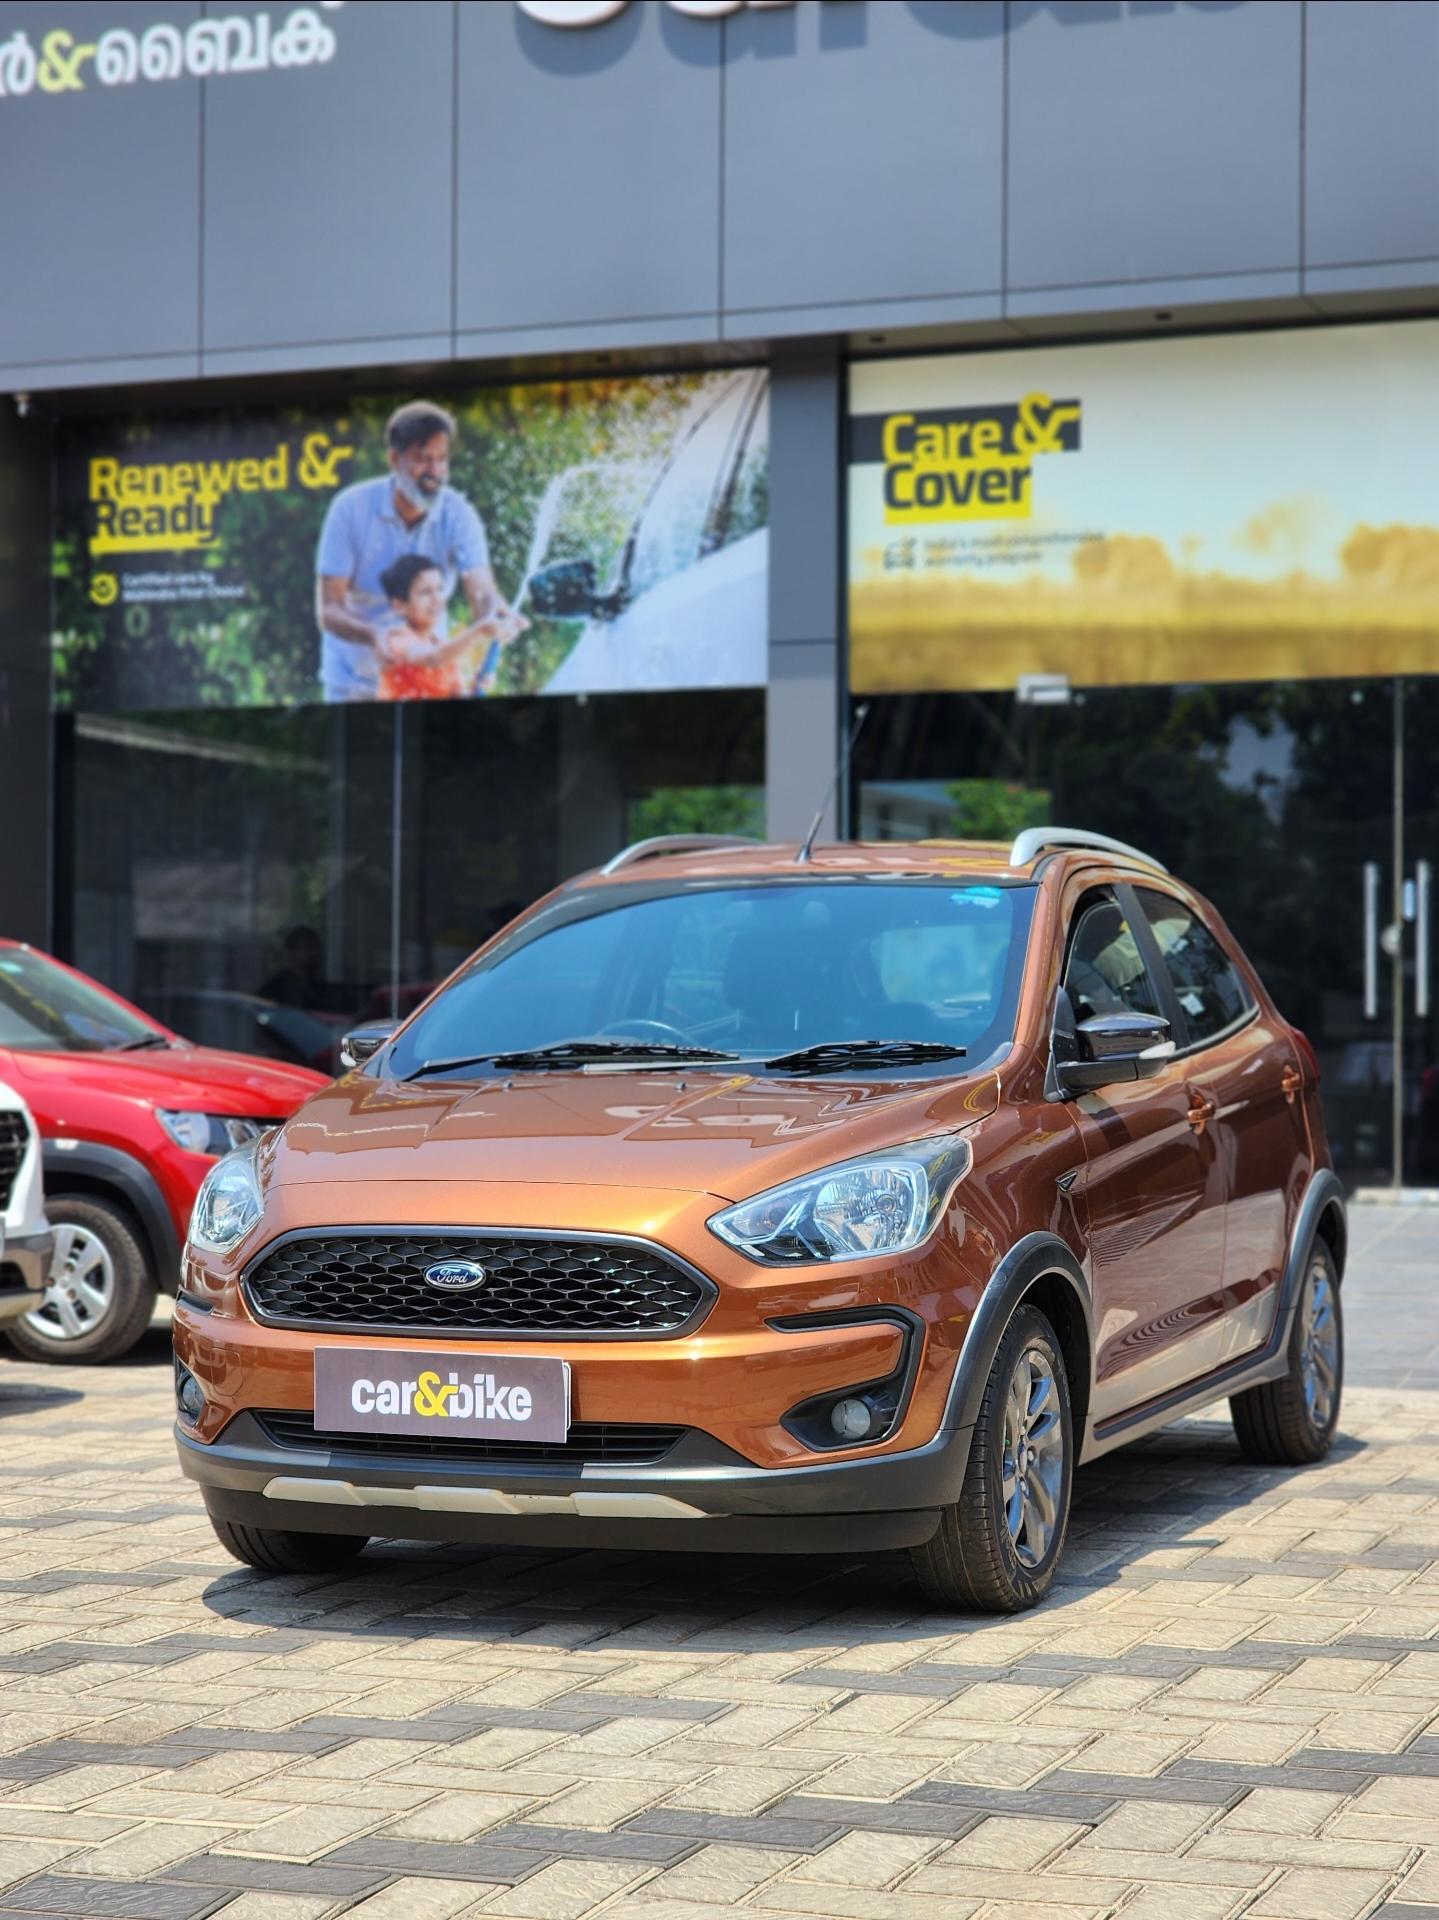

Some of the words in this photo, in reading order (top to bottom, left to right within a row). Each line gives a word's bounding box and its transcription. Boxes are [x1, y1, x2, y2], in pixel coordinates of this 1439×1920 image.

[882, 413, 1003, 462] Care
[1012, 391, 1082, 453] &
[89, 444, 288, 501] Renewed
[299, 432, 353, 488] &
[884, 463, 1031, 510] Cover
[91, 497, 220, 544] Ready
[436, 1267, 469, 1285] Ford
[351, 1371, 532, 1421] car&bike
